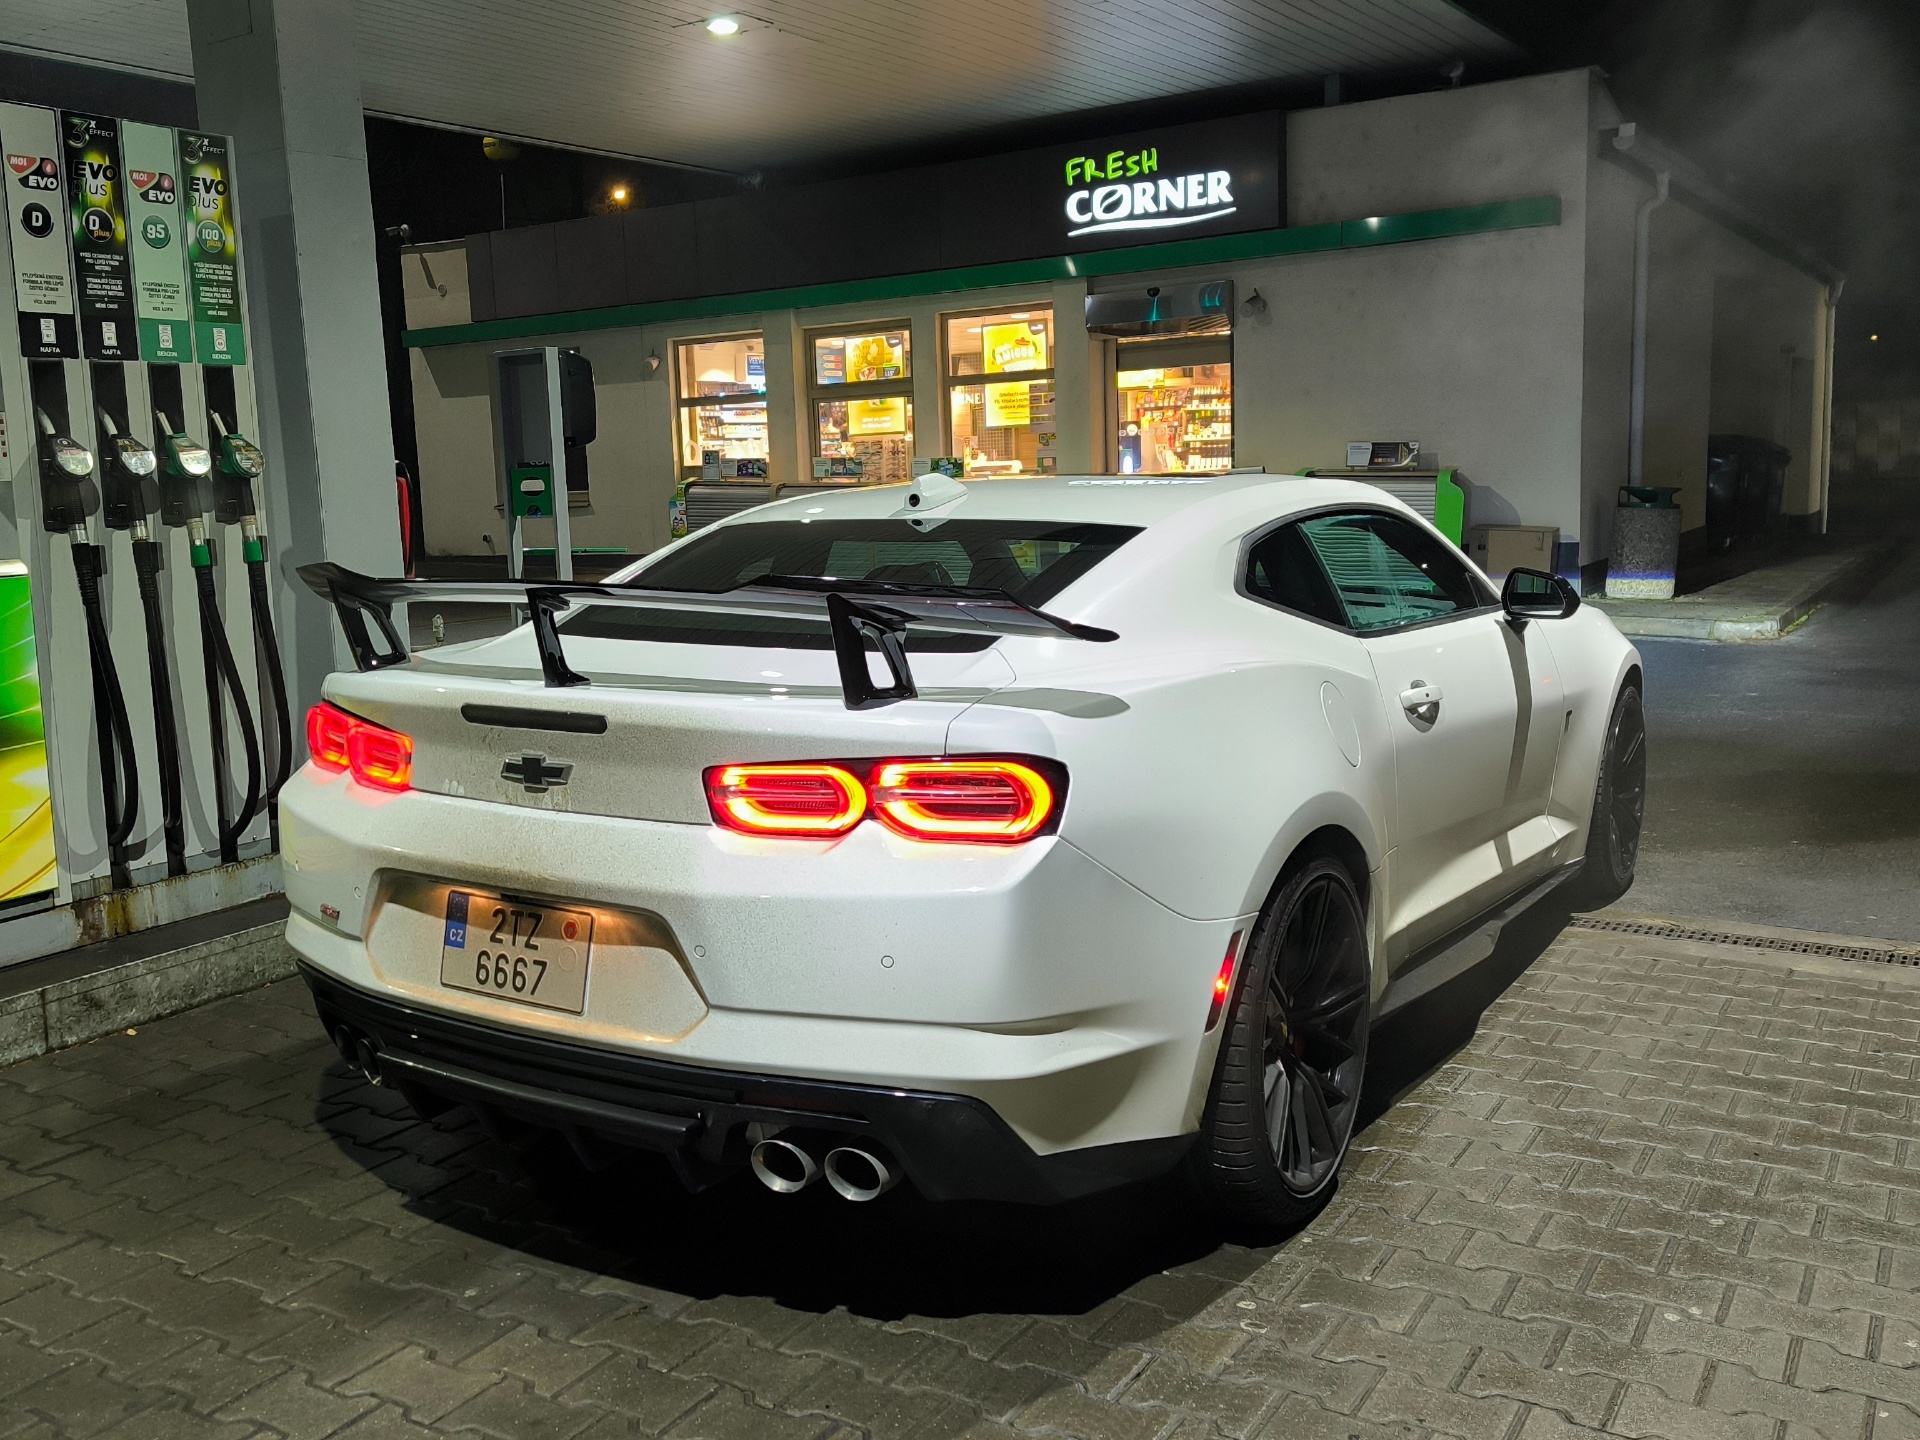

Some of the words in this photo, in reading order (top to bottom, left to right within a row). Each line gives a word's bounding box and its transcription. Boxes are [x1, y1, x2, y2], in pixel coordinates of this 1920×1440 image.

[89, 129, 114, 137] EFFECT
[203, 146, 225, 154] EFFECT
[10, 156, 27, 166] MOL
[1066, 148, 1158, 186] FRESH
[73, 160, 118, 182] EVO
[132, 172, 147, 181] MOL
[28, 175, 58, 189] EVO
[72, 178, 107, 197] plus
[188, 175, 228, 196] EVO
[148, 190, 174, 203] EVO
[188, 192, 218, 209] plus
[1065, 170, 1234, 224] CORNER
[32, 212, 42, 226] D
[89, 216, 99, 230] D
[147, 224, 165, 239] 95
[202, 229, 219, 240] 100
[450, 928, 464, 942] CZ
[490, 906, 543, 950] 2TZ
[476, 950, 548, 996] 6667
